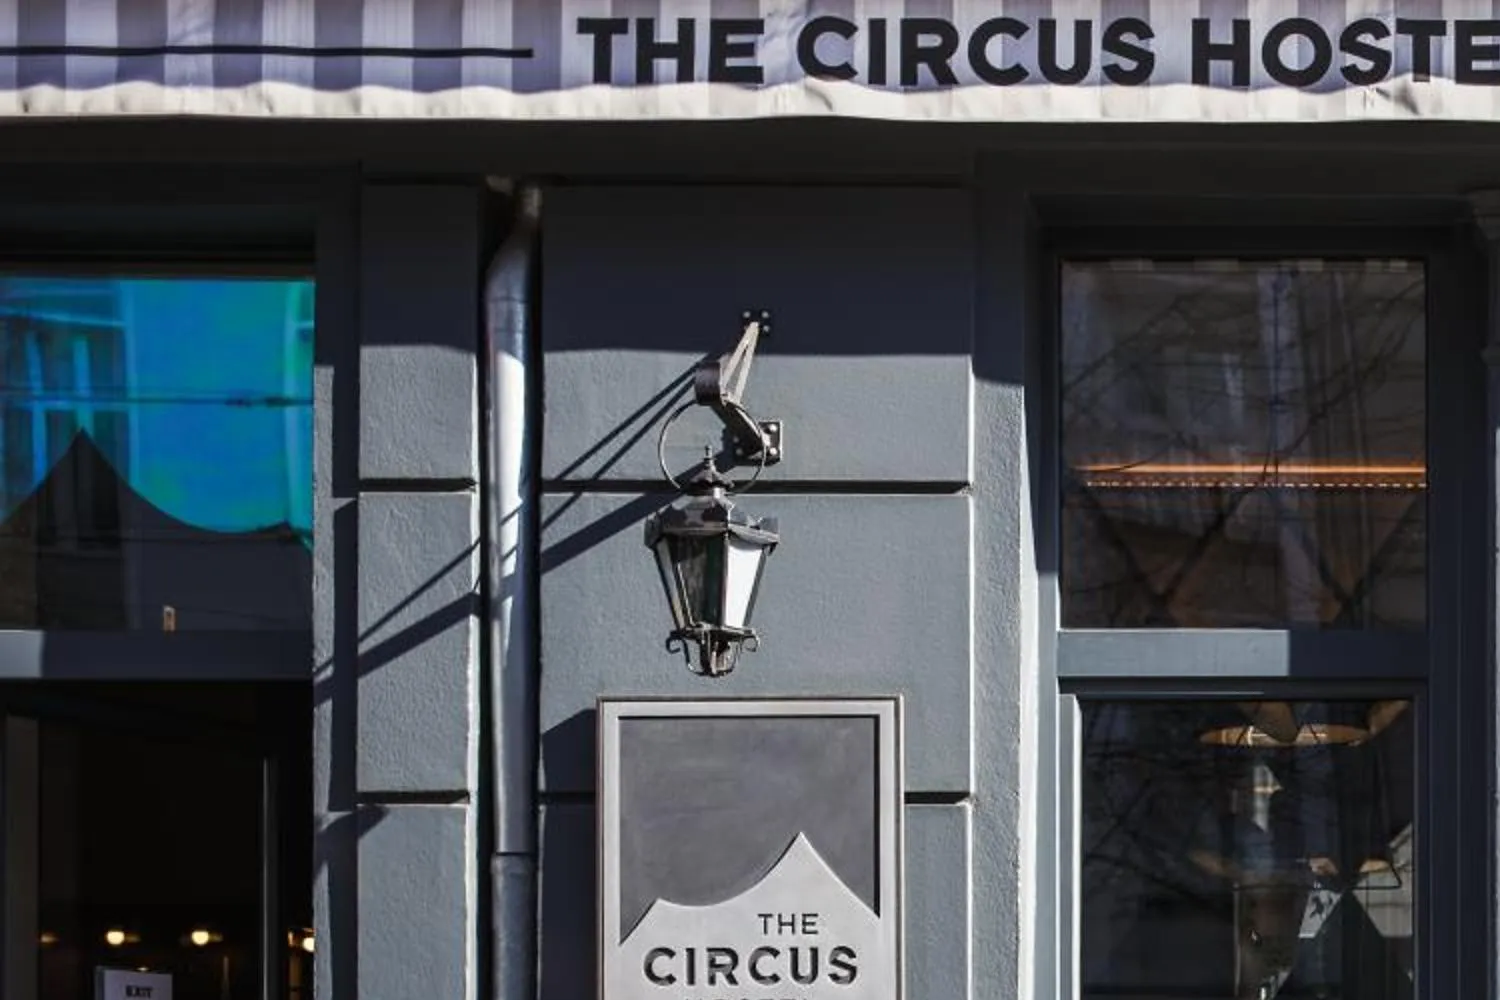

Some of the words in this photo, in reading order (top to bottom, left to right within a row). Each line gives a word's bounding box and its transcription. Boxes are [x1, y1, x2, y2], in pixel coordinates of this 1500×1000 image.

[578, 17, 765, 85] THE
[797, 15, 1155, 87] CIRCUS
[757, 913, 819, 935] THE
[644, 945, 858, 986] CIRCUS
[126, 985, 153, 998] EXIT
